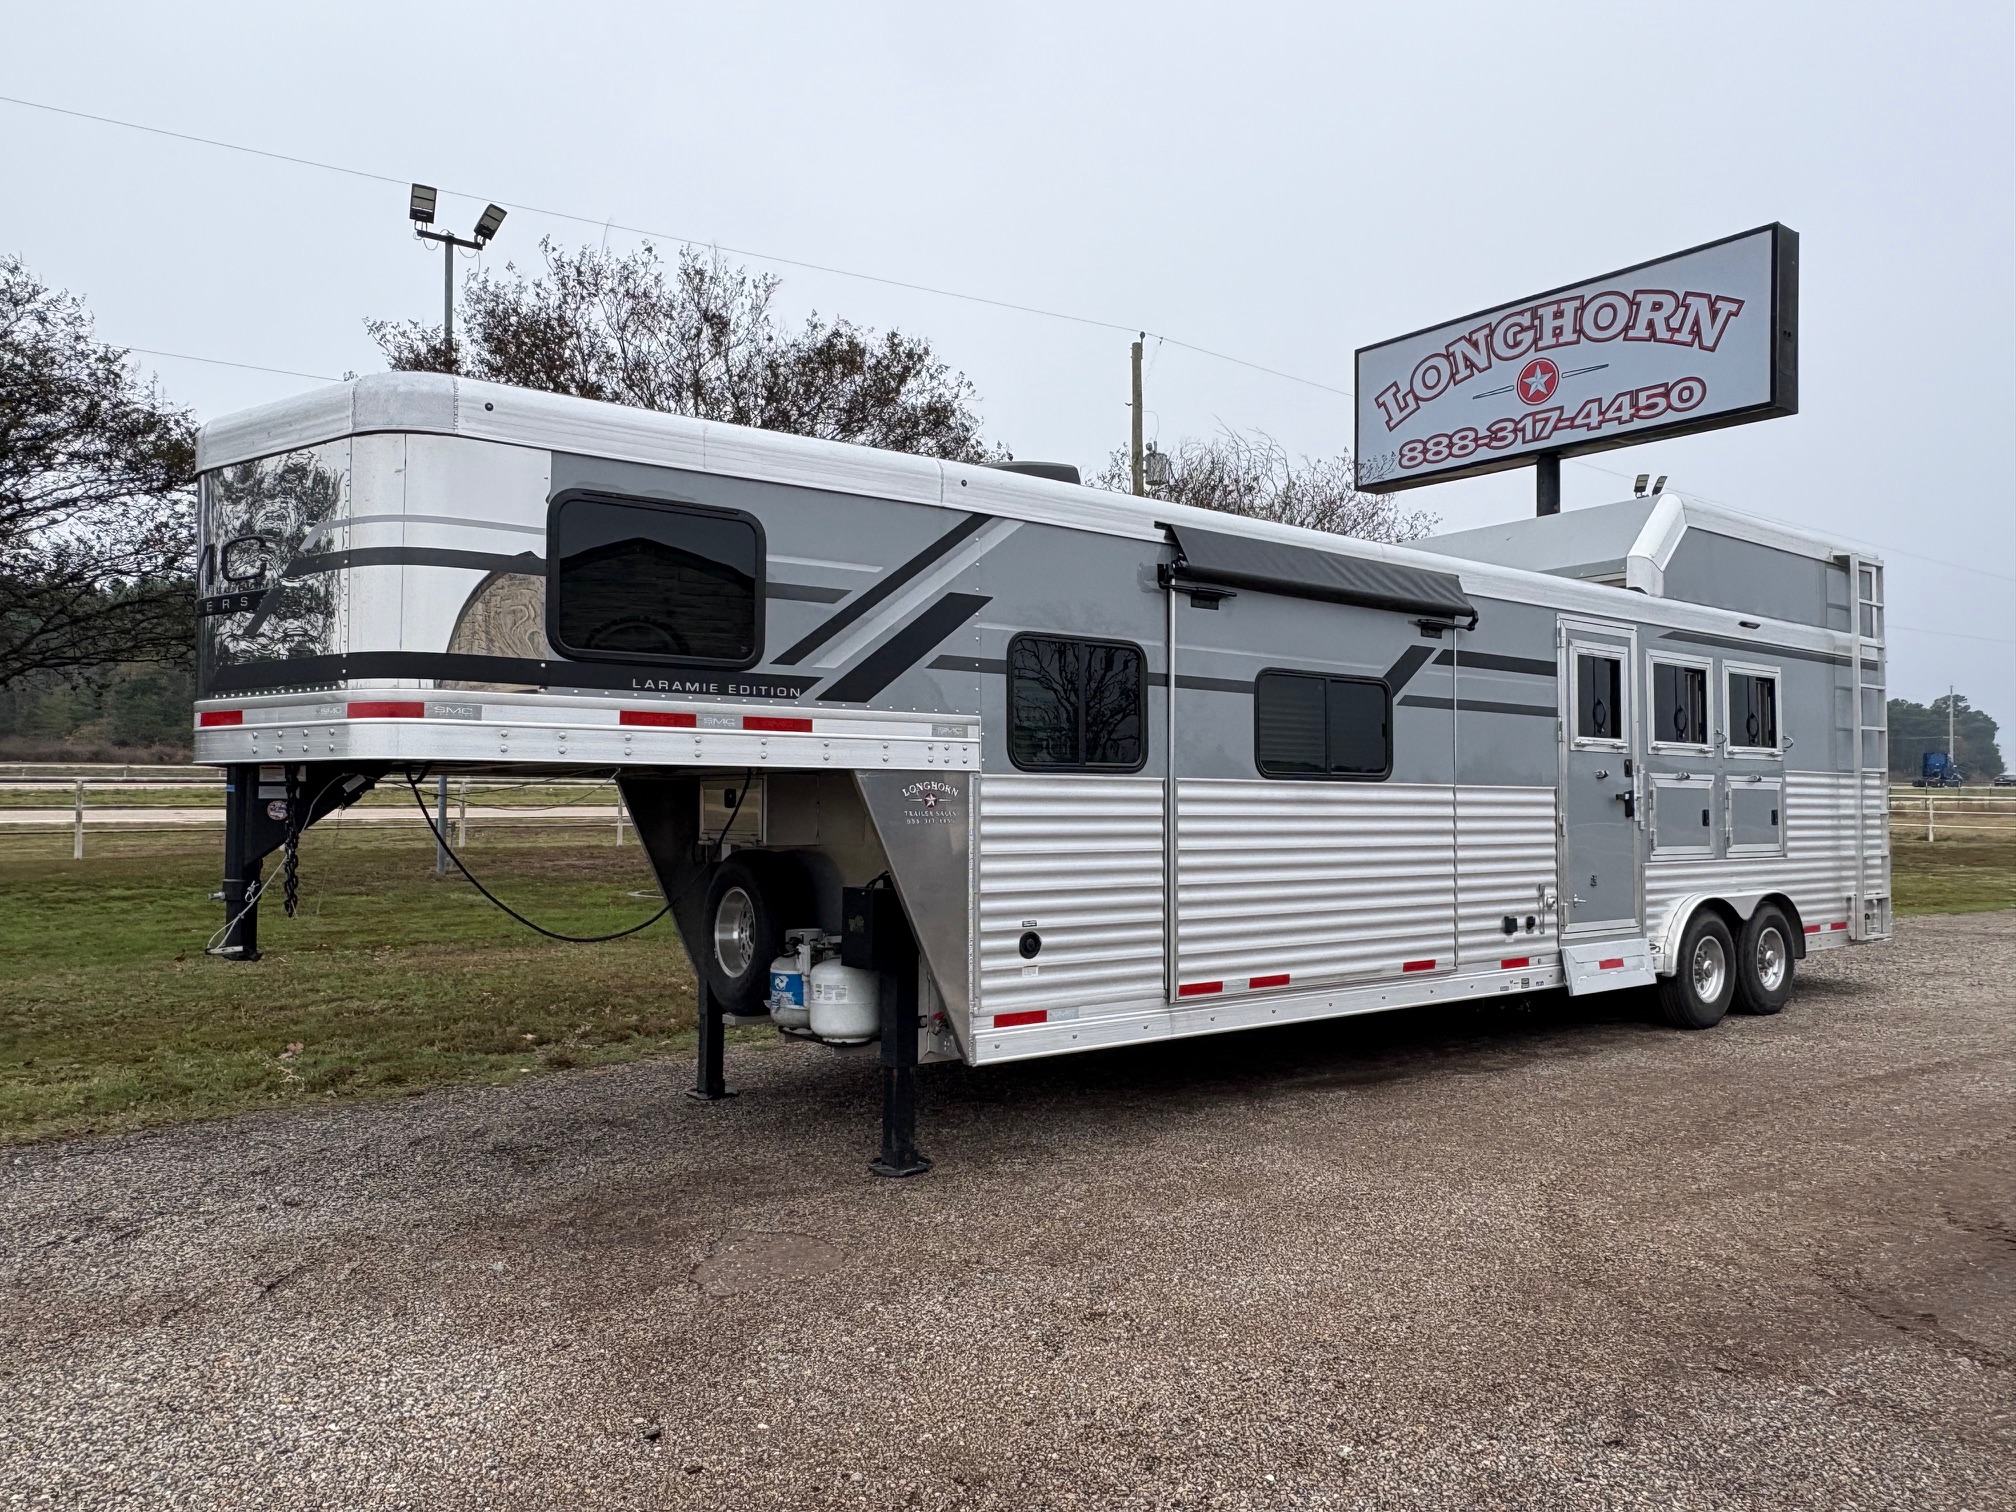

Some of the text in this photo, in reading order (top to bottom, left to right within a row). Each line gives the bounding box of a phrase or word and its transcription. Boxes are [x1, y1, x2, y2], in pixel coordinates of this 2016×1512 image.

[1375, 289, 1745, 431] LONGHORN
[1399, 376, 1707, 469] 888-317-4450
[632, 678, 800, 697] LARAMIE EDITION
[434, 706, 473, 715] SMC
[703, 717, 735, 725] SMC
[901, 781, 959, 797] LONGHORN
